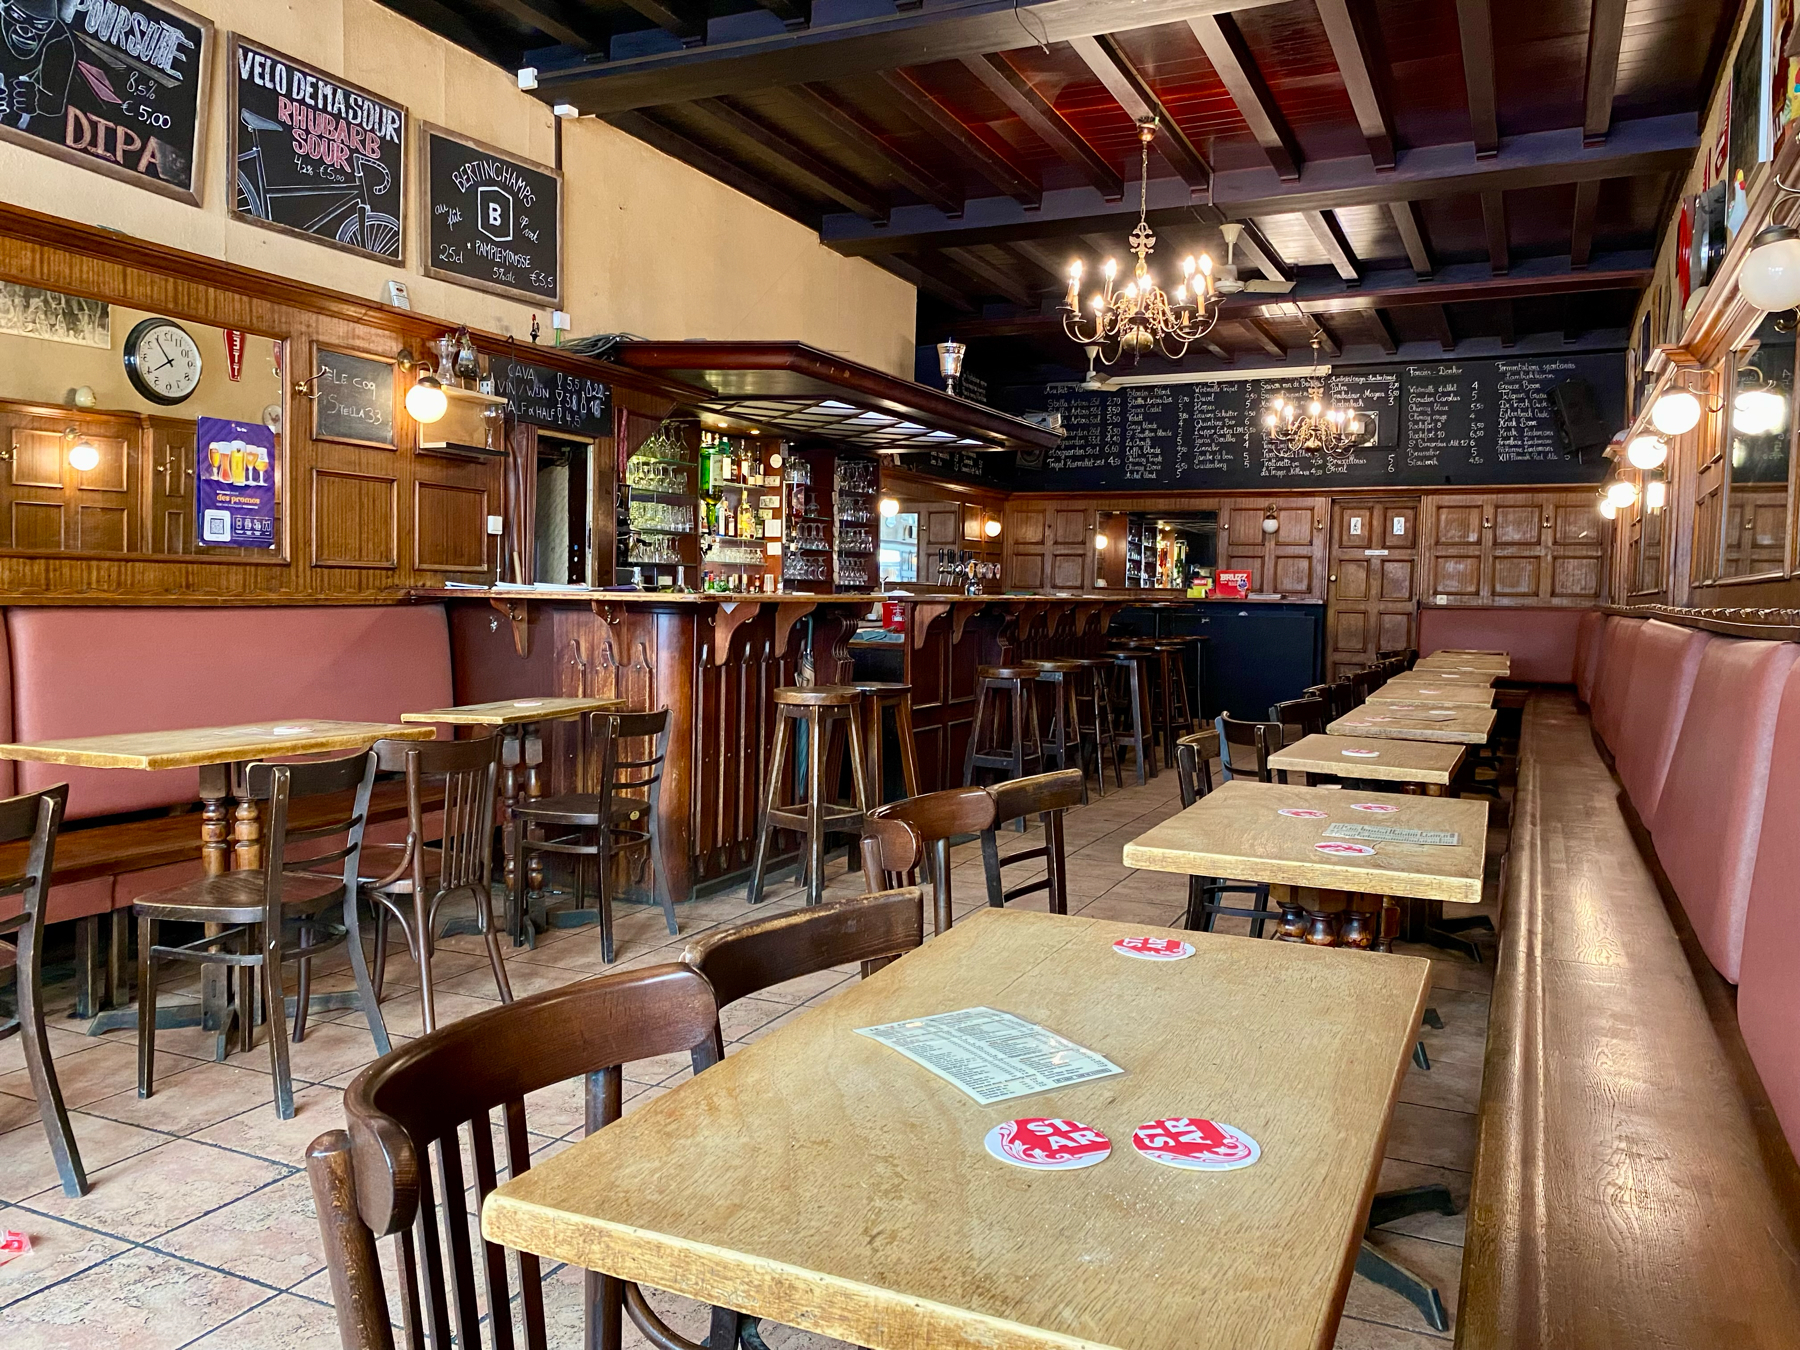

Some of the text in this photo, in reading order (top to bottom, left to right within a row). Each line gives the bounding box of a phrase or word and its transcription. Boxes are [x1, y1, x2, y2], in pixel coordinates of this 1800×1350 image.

[126, 71, 156, 101] 8,5%
[239, 48, 287, 95] VELO
[349, 94, 401, 144] SOUR
[138, 105, 172, 129] 5,00
[278, 96, 382, 159] RHUBARB
[66, 105, 163, 176] DIPA
[292, 128, 352, 173] SOUR
[451, 159, 536, 208] BERTINCHAMPS
[434, 203, 449, 215] au
[488, 202, 502, 226] B
[447, 206, 463, 232] fût
[519, 215, 530, 229] op
[522, 229, 540, 244] vat
[439, 243, 463, 264] 25cl
[475, 239, 532, 269] PAMPLEMOUSSE
[507, 363, 536, 382] CAVA
[497, 379, 516, 395] VIN
[526, 384, 550, 399] WIJN
[1220, 383, 1252, 394] Tripel 5
[1260, 381, 1281, 391] Saison
[1471, 381, 1478, 390] 4
[1522, 380, 1541, 390] Boon
[1194, 393, 1215, 402] Duvel
[1362, 388, 1386, 400] Magma
[1408, 391, 1478, 403] Gouden Carolus 5
[1047, 398, 1089, 408] Stella Artois
[1245, 400, 1251, 409] 5
[1330, 398, 1364, 408] Rodenbach
[1387, 396, 1394, 406] 3
[1498, 399, 1548, 408] De Troch Oude
[1071, 407, 1089, 415] Artois
[1178, 403, 1183, 412] 5
[1408, 404, 1431, 414] Chimay
[365, 407, 382, 425] 33
[536, 405, 556, 421] HALF
[1408, 413, 1431, 423] Chimay
[1534, 409, 1549, 418] Oude
[1069, 415, 1089, 424] Artois
[1178, 420, 1183, 428] 4
[1244, 417, 1250, 425] 6
[1498, 418, 1538, 428] Kriek Boon
[1436, 421, 1442, 429] 8
[1177, 428, 1183, 437] 5
[1216, 427, 1233, 435] Extra
[1437, 430, 1446, 438] 10
[1523, 428, 1554, 436] Lindemans
[1176, 436, 1182, 445] 5
[1192, 433, 1249, 444] Taras Boulba 4
[1460, 439, 1469, 447] 12
[1469, 438, 1475, 447] 6
[1523, 437, 1553, 445] Lindemans
[1243, 441, 1249, 449] 4
[1126, 446, 1142, 458] Leffe
[1176, 452, 1183, 462] 5
[1243, 452, 1249, 461] 5
[1471, 447, 1477, 457] 5
[1387, 455, 1395, 464] 5
[1498, 453, 1509, 462] XII
[1244, 460, 1250, 469] 5
[1325, 464, 1395, 473] Orval 6
[1175, 469, 1181, 479] 5
[216, 493, 260, 505] des promos
[1220, 573, 1248, 581] BRUZZ
